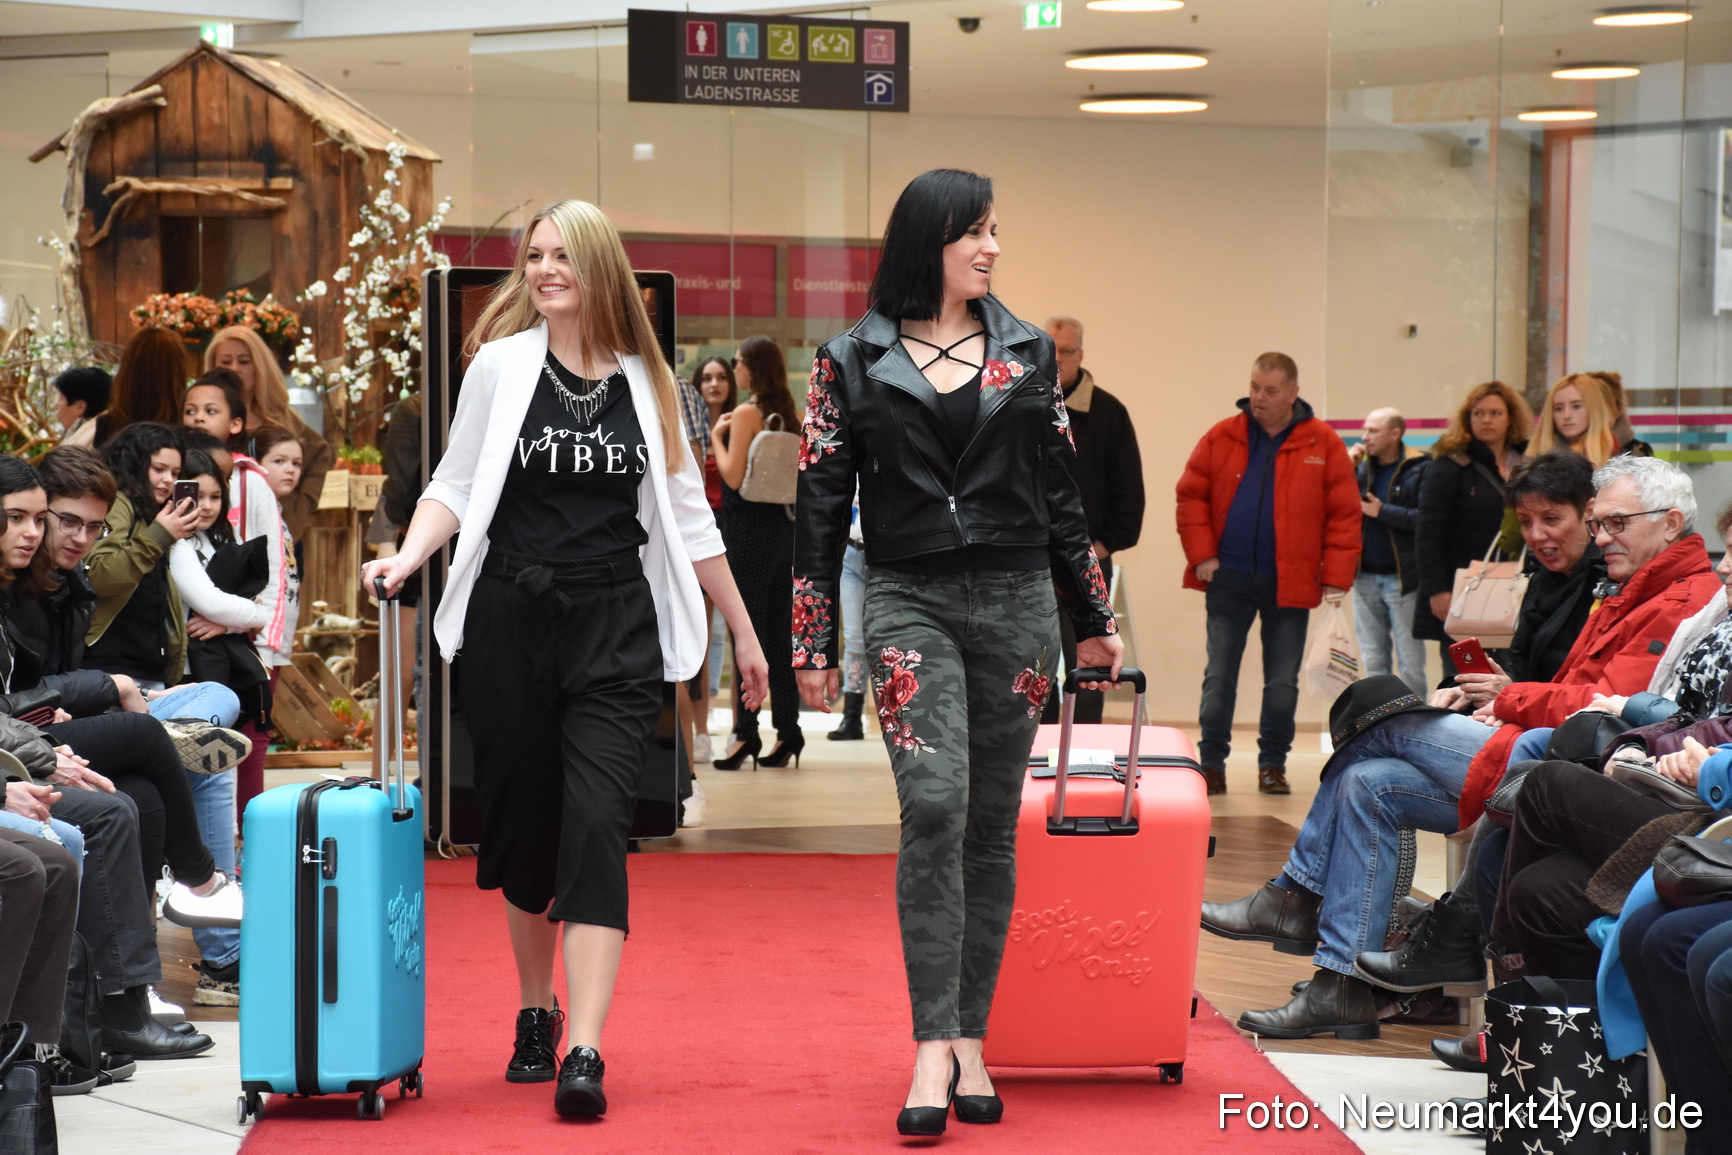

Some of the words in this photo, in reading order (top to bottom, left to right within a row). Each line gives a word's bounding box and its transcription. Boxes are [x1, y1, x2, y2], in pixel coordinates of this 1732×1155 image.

[684, 64, 698, 79] IN
[702, 65, 728, 80] DER
[734, 66, 800, 83] UNTEREN
[684, 84, 800, 103] LADENSTRASSE
[872, 81, 887, 102] P
[675, 276, 714, 289] raxis-
[716, 277, 742, 290] und
[793, 278, 871, 293] Dienstleistu
[536, 424, 614, 451] good
[518, 438, 647, 474] VIBES
[365, 484, 380, 497] Ei
